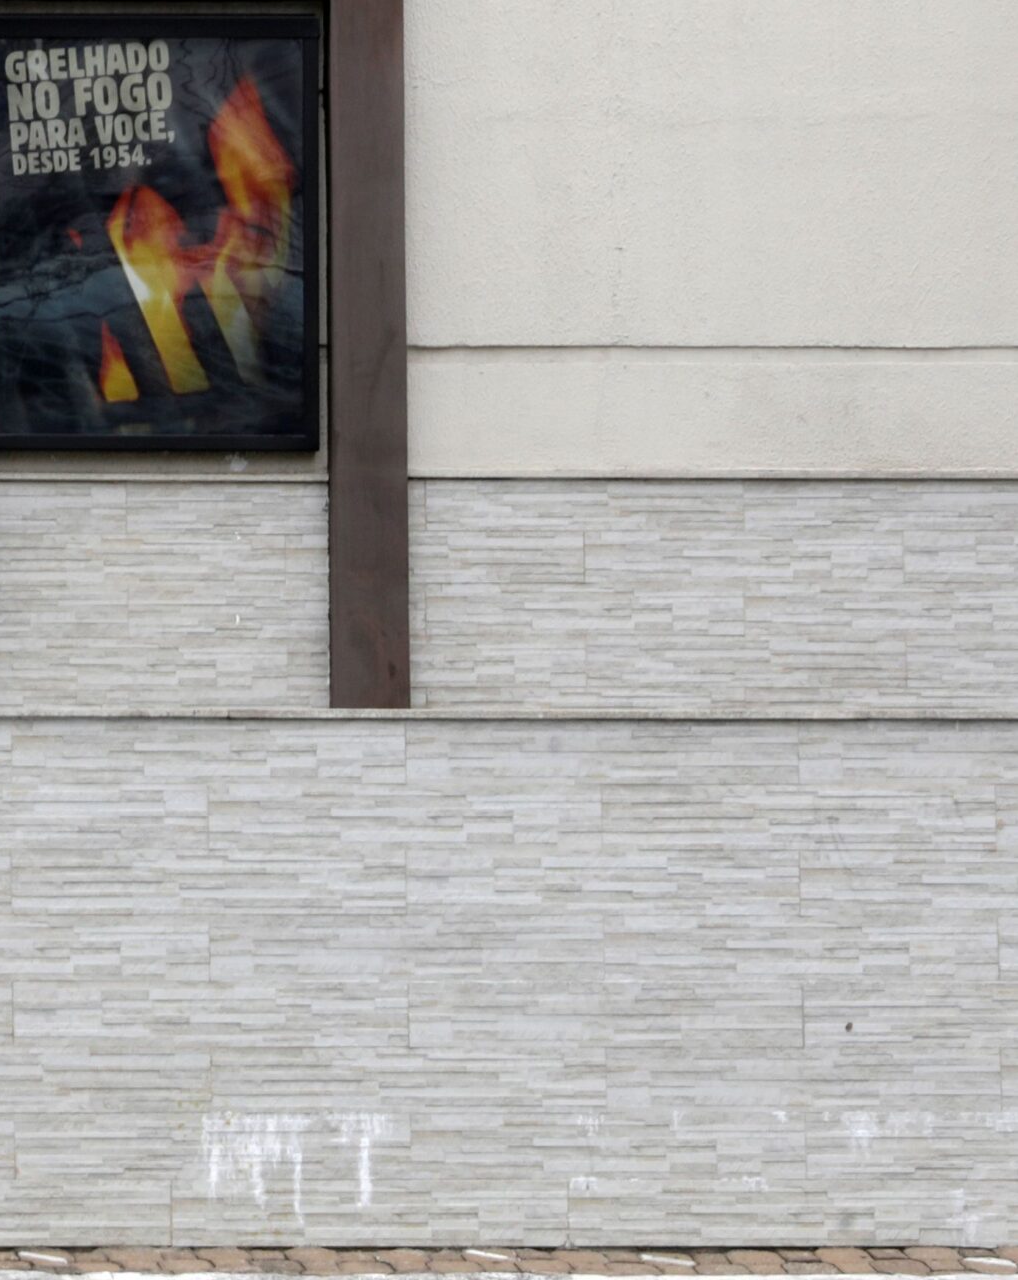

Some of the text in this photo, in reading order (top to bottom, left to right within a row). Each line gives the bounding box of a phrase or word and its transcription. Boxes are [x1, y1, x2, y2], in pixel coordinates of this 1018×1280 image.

[4, 40, 170, 84] GRELHADO
[7, 72, 173, 121] NO FOGO
[9, 117, 87, 152] PARA
[12, 144, 152, 176] DESDE 1954.
